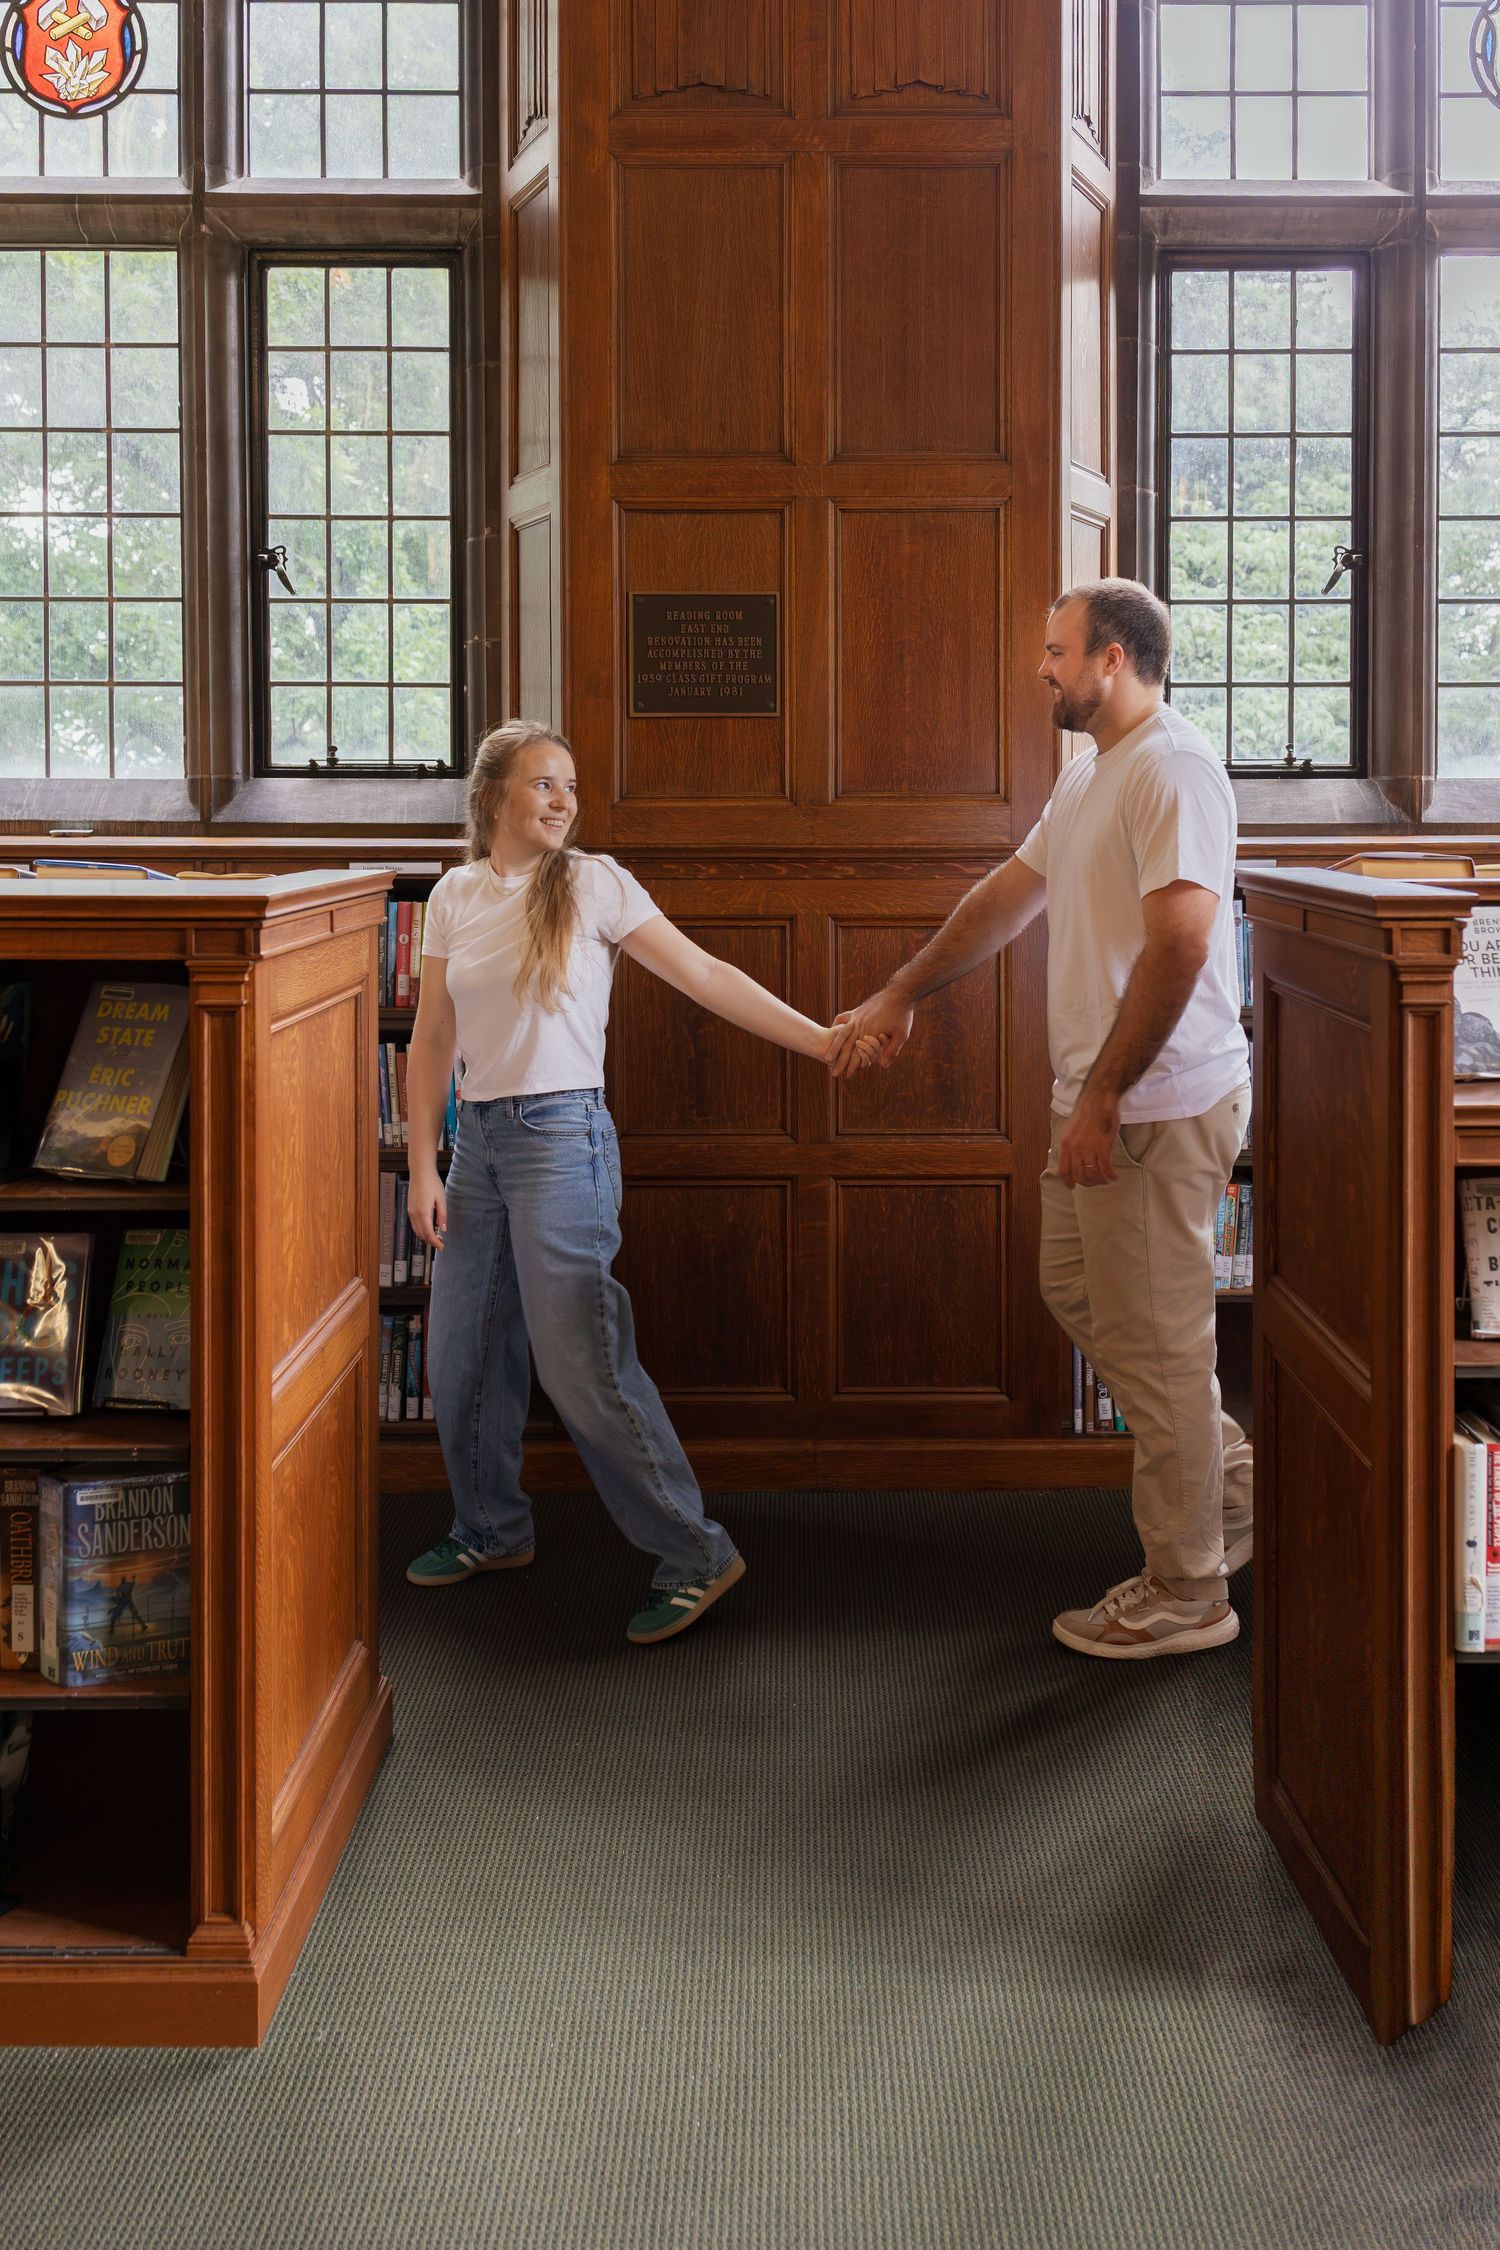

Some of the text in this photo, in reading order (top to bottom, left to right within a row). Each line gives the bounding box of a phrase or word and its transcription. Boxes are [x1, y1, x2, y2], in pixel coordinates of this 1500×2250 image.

[666, 611, 743, 621] READING ROOM
[680, 624, 729, 634] EAST END
[647, 636, 763, 646] RENOVATION HAS BEEN
[647, 649, 763, 659] ACCOMPLISHED BY THE
[659, 661, 749, 671] MEMBERS OF THE
[637, 674, 772, 684] 1959 CLASS GIFT PROGRAM
[668, 687, 743, 696] JANUARY 1981
[1472, 918, 1500, 926] BREN
[1481, 953, 1500, 964] BE
[96, 1001, 171, 1022] DREAM
[96, 1026, 156, 1047] STATE
[88, 1065, 136, 1087] ERIC
[56, 1089, 151, 1116] PUCHNER
[1487, 1217, 1500, 1233] C
[1488, 1256, 1500, 1271] B
[105, 1367, 187, 1382] ROONEY
[94, 1486, 174, 1522] BRANDON
[77, 1514, 191, 1558] SANDERSON
[72, 1646, 119, 1672] WIND
